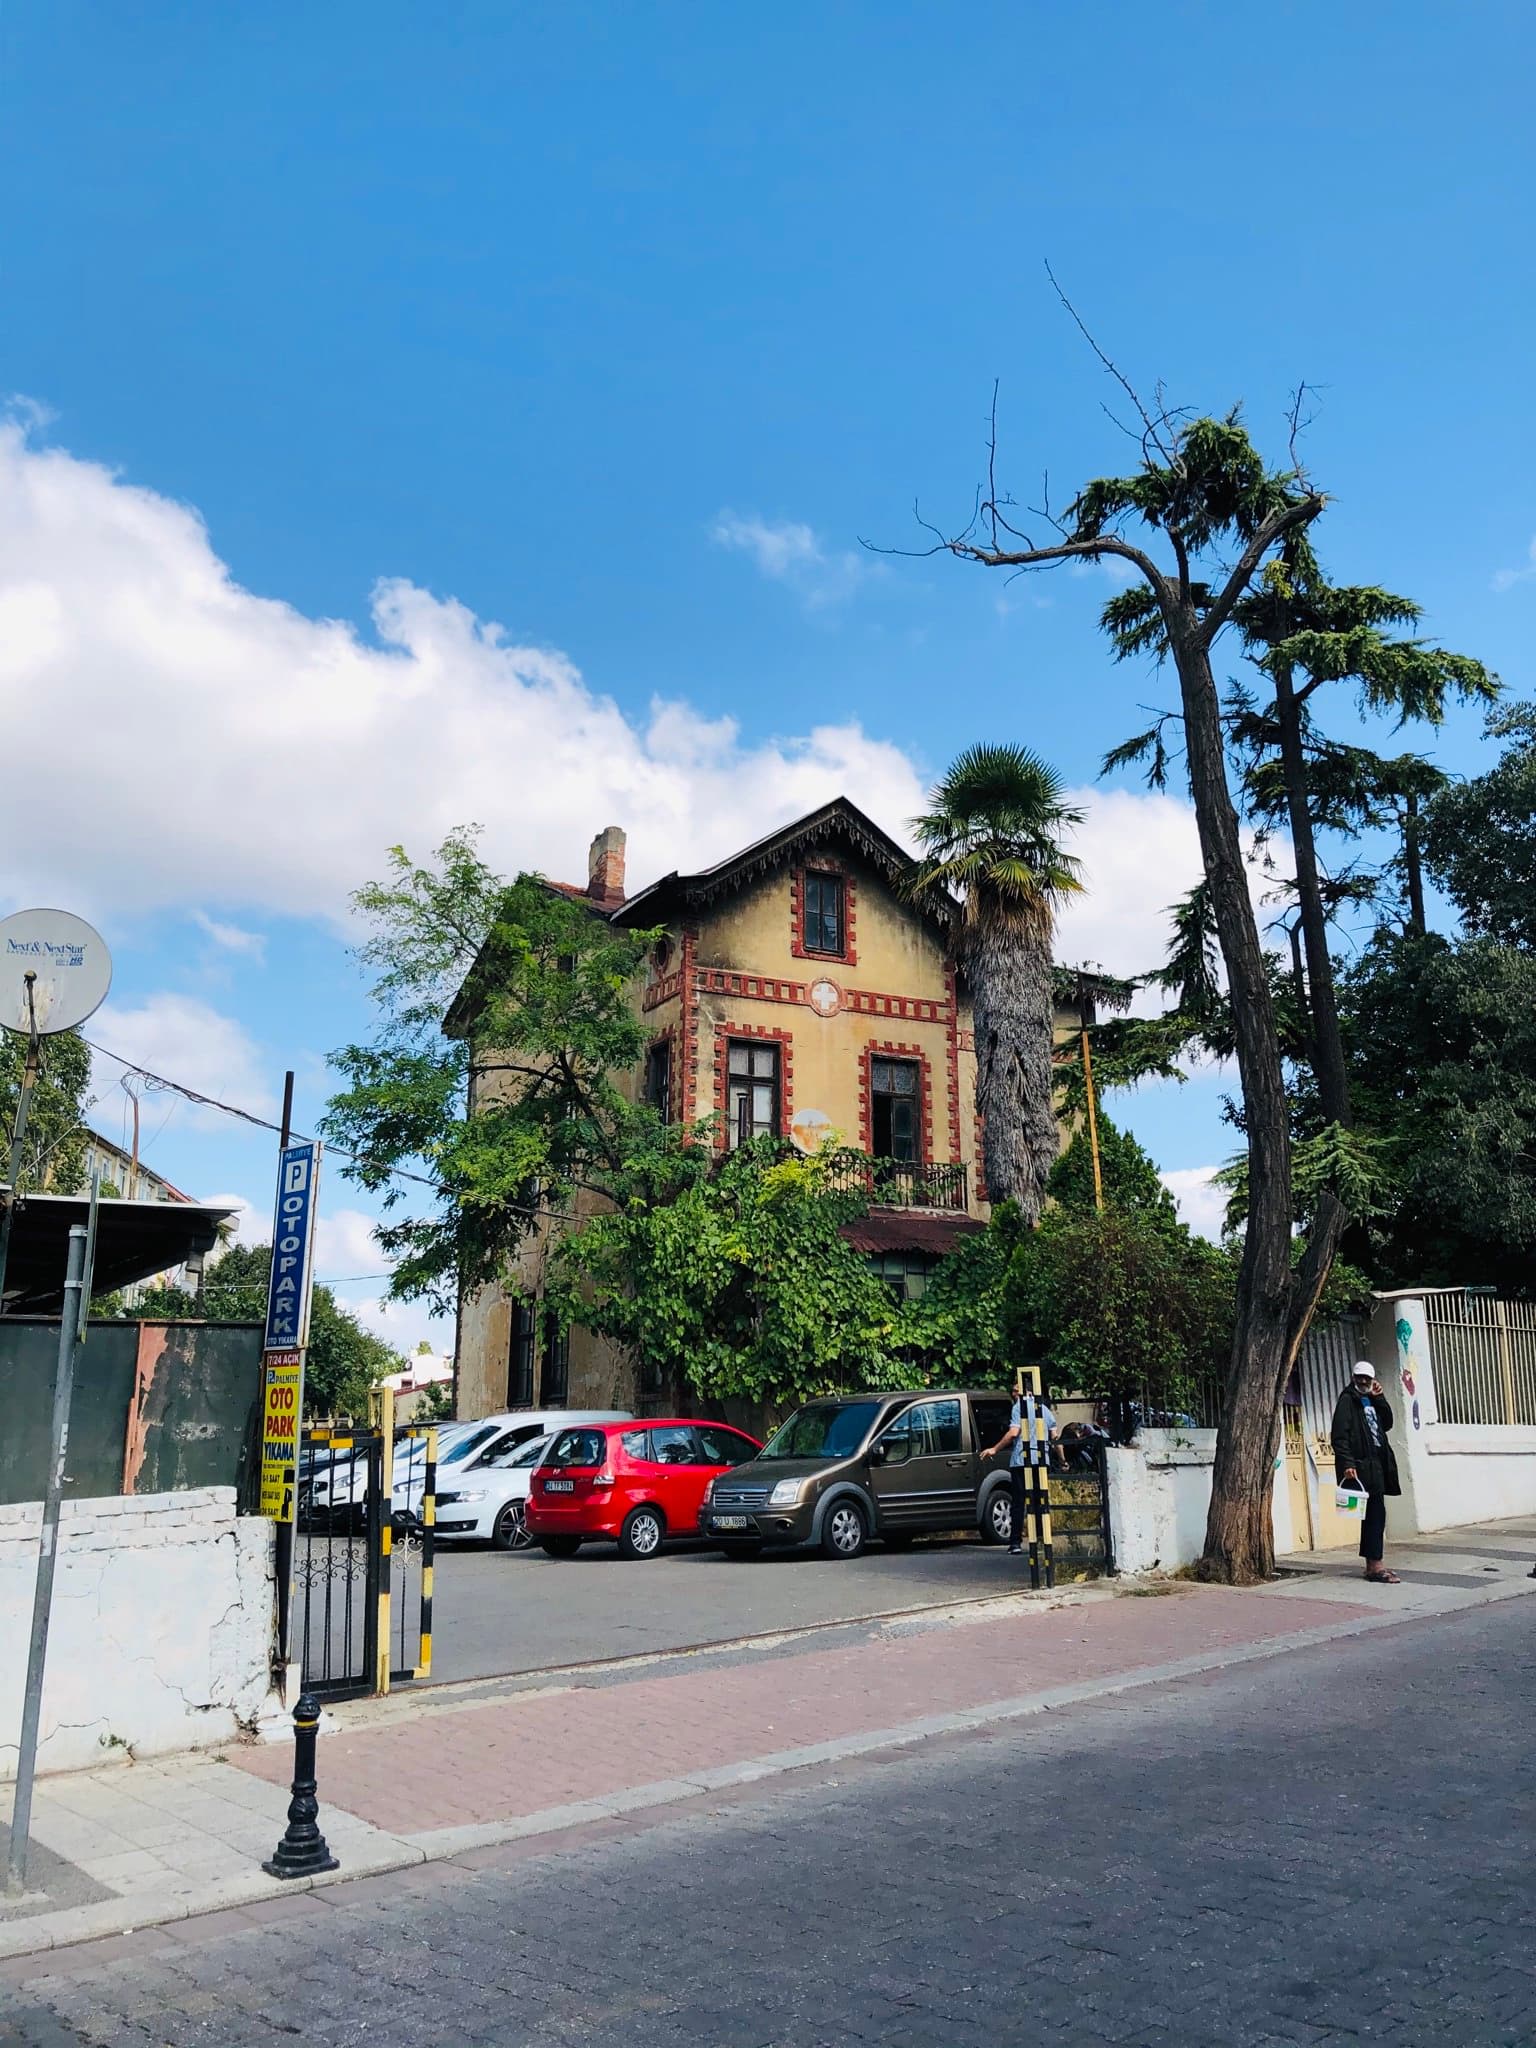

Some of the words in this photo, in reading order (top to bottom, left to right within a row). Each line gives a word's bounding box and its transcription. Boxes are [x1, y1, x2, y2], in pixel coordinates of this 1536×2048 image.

[31, 941, 40, 952] &
[291, 1165, 301, 1190] P
[273, 1197, 303, 1334] OTOPARK
[283, 1353, 299, 1367] AÇIK
[270, 1387, 294, 1410] OTO
[266, 1415, 295, 1438] PARK
[264, 1442, 295, 1461] YIKAMA
